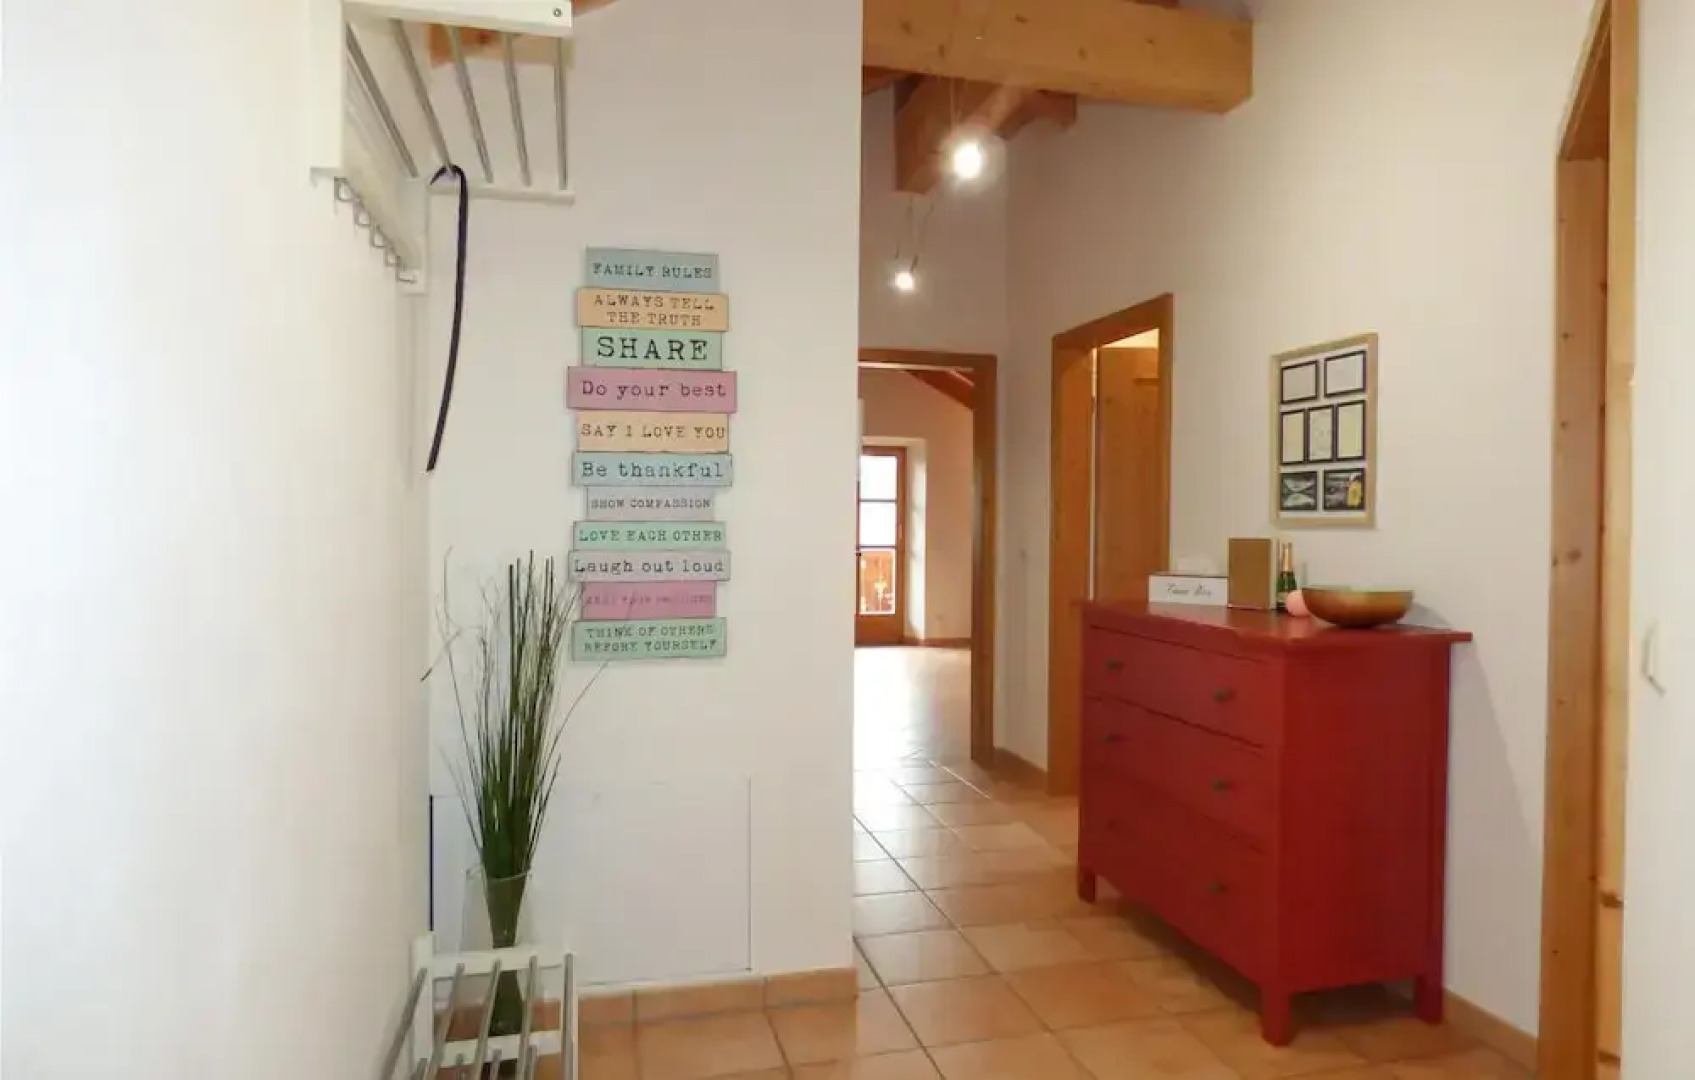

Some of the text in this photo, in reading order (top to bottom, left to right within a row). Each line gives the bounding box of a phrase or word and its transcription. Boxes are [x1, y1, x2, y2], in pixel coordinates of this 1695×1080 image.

[592, 262, 712, 278] FAMILY RULES
[594, 295, 715, 310] ALWAYS TELL
[607, 311, 702, 326] THE TRUTH
[597, 336, 708, 360] SHARE
[582, 381, 726, 400] Do your best
[581, 424, 726, 438] SAY I LOVE YOU
[582, 462, 724, 479] Be thankful
[591, 499, 711, 508] SHOW COMPASSION
[579, 529, 722, 542] LOVE EACH OTHER
[574, 559, 724, 575] Laugh out loud
[586, 624, 714, 639] THINK OF OTHERS
[584, 639, 717, 652] BEFORE YOURSELF
